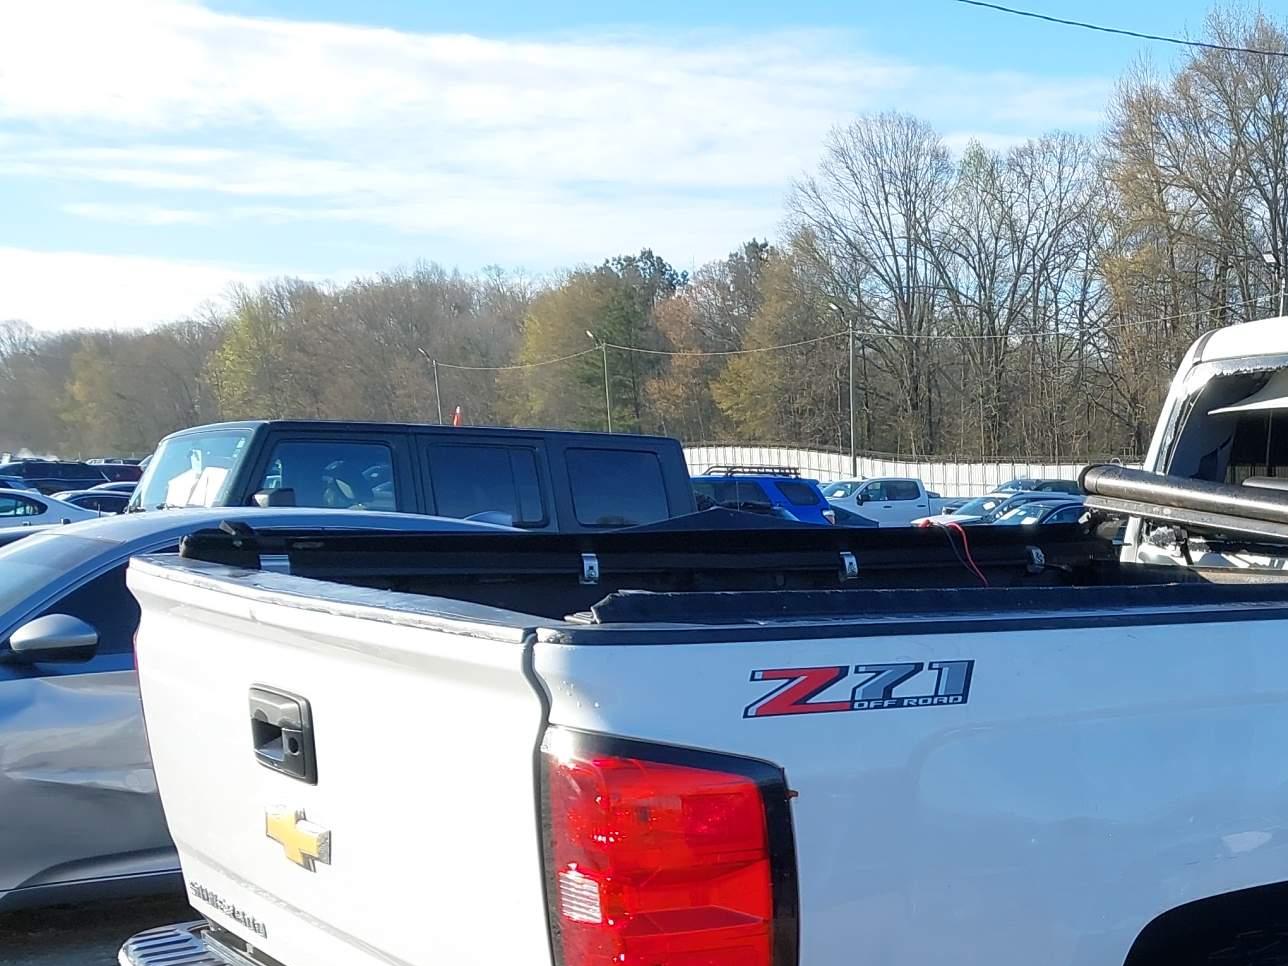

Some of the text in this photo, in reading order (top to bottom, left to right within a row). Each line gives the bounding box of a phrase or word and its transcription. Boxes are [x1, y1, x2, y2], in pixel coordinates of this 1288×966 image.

[742, 659, 976, 719] Z71
[853, 695, 963, 710] OFF ROAD
